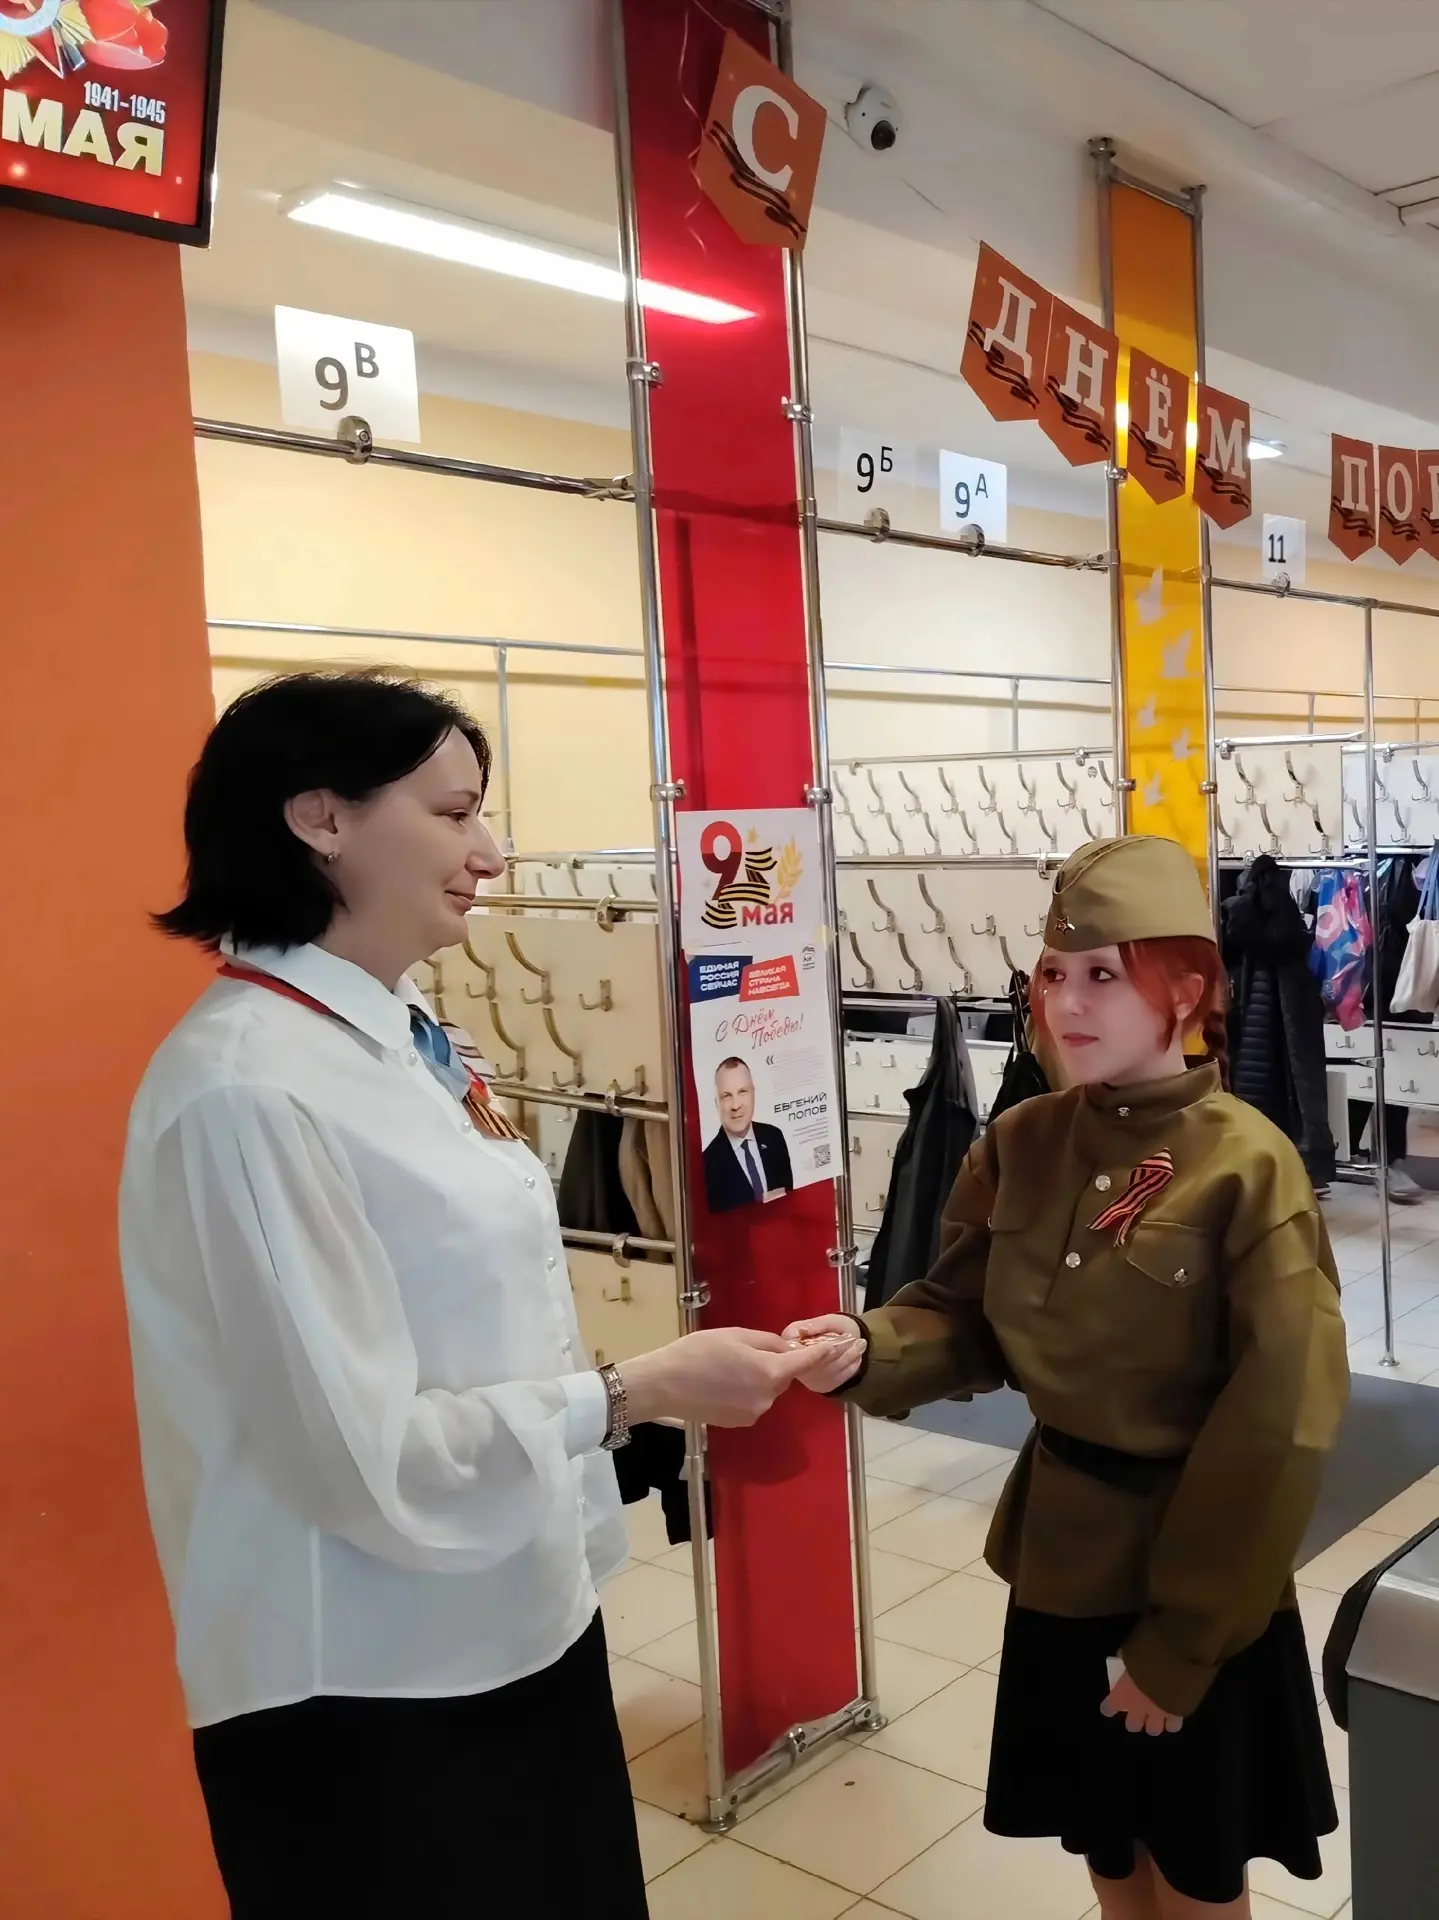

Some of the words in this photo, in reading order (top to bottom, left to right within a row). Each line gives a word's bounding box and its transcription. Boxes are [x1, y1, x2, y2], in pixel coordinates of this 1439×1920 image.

[1, 88, 165, 177] МАЯ
[732, 84, 799, 192] С
[1268, 533, 1287, 563] 11
[700, 820, 743, 901] 9
[774, 1092, 827, 1114] ЕВГЕНИЙ
[788, 1104, 827, 1122] ПОПОВ
